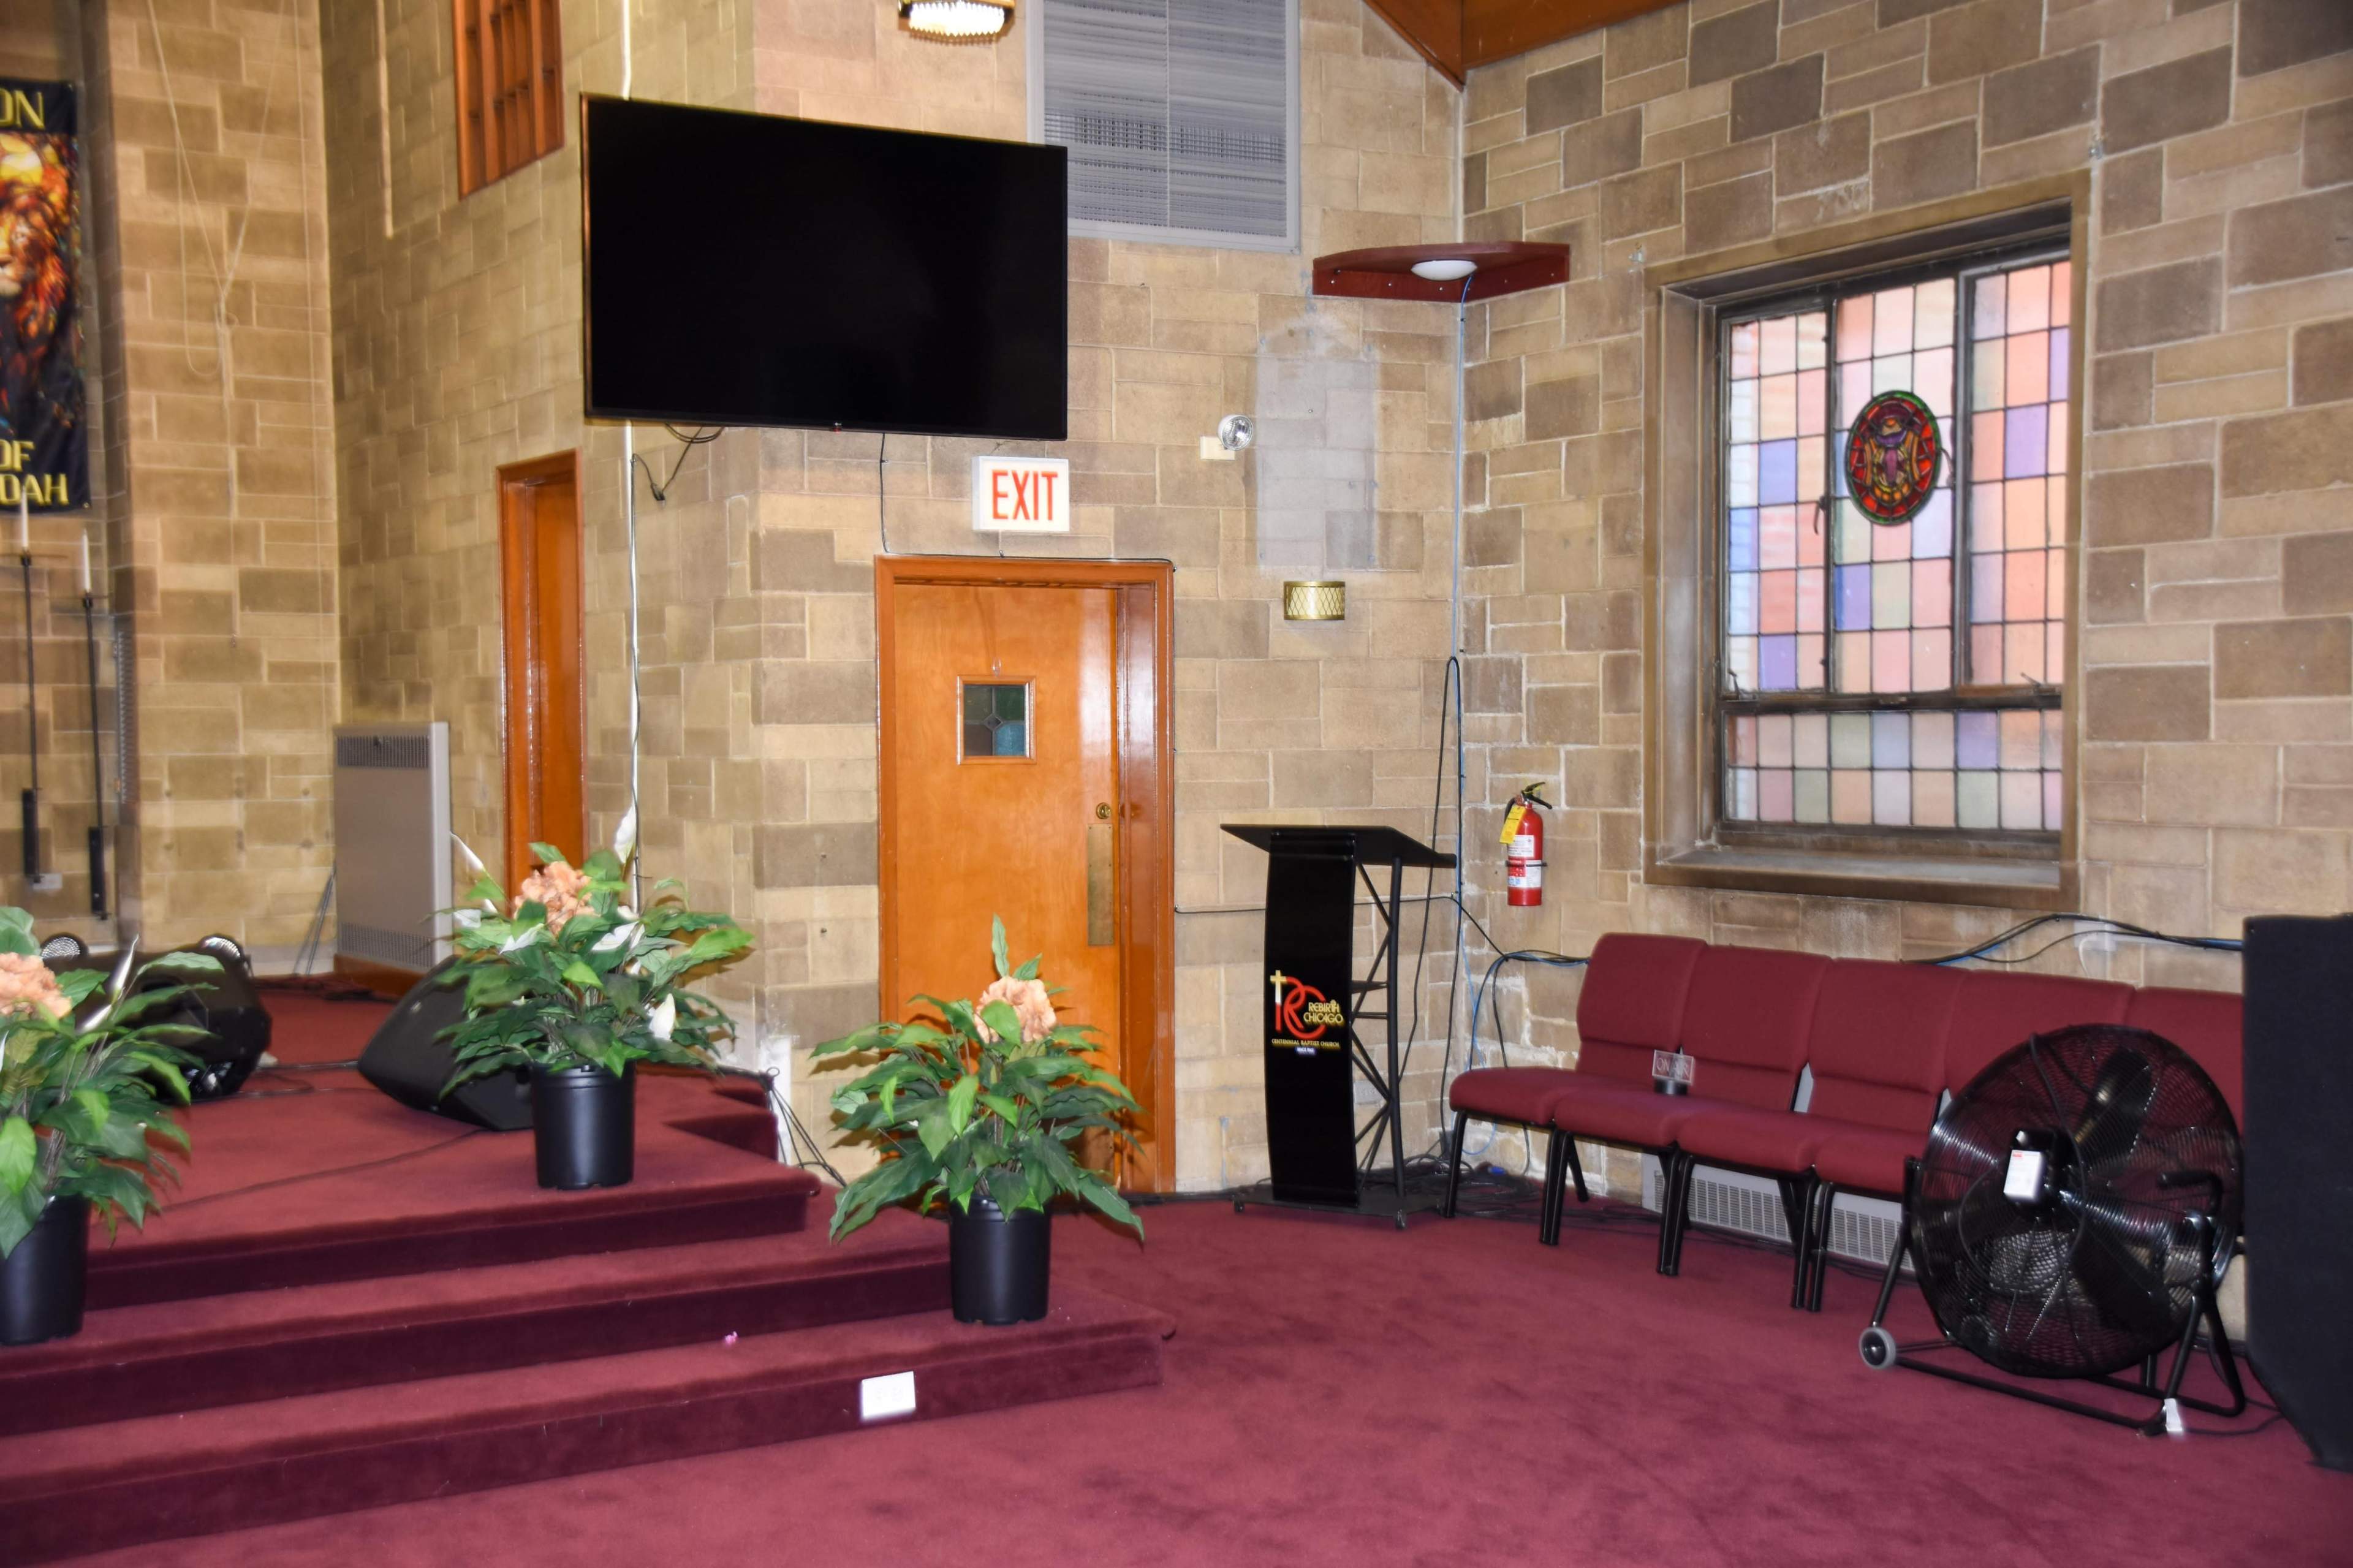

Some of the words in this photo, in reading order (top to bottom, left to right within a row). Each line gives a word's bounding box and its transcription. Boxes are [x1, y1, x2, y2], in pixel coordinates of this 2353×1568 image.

[991, 469, 1058, 521] EXIT
[1308, 1001, 1339, 1013] REBIRTH
[1303, 1012, 1343, 1023] CHICAGO
[1656, 1058, 1670, 1072] ON
